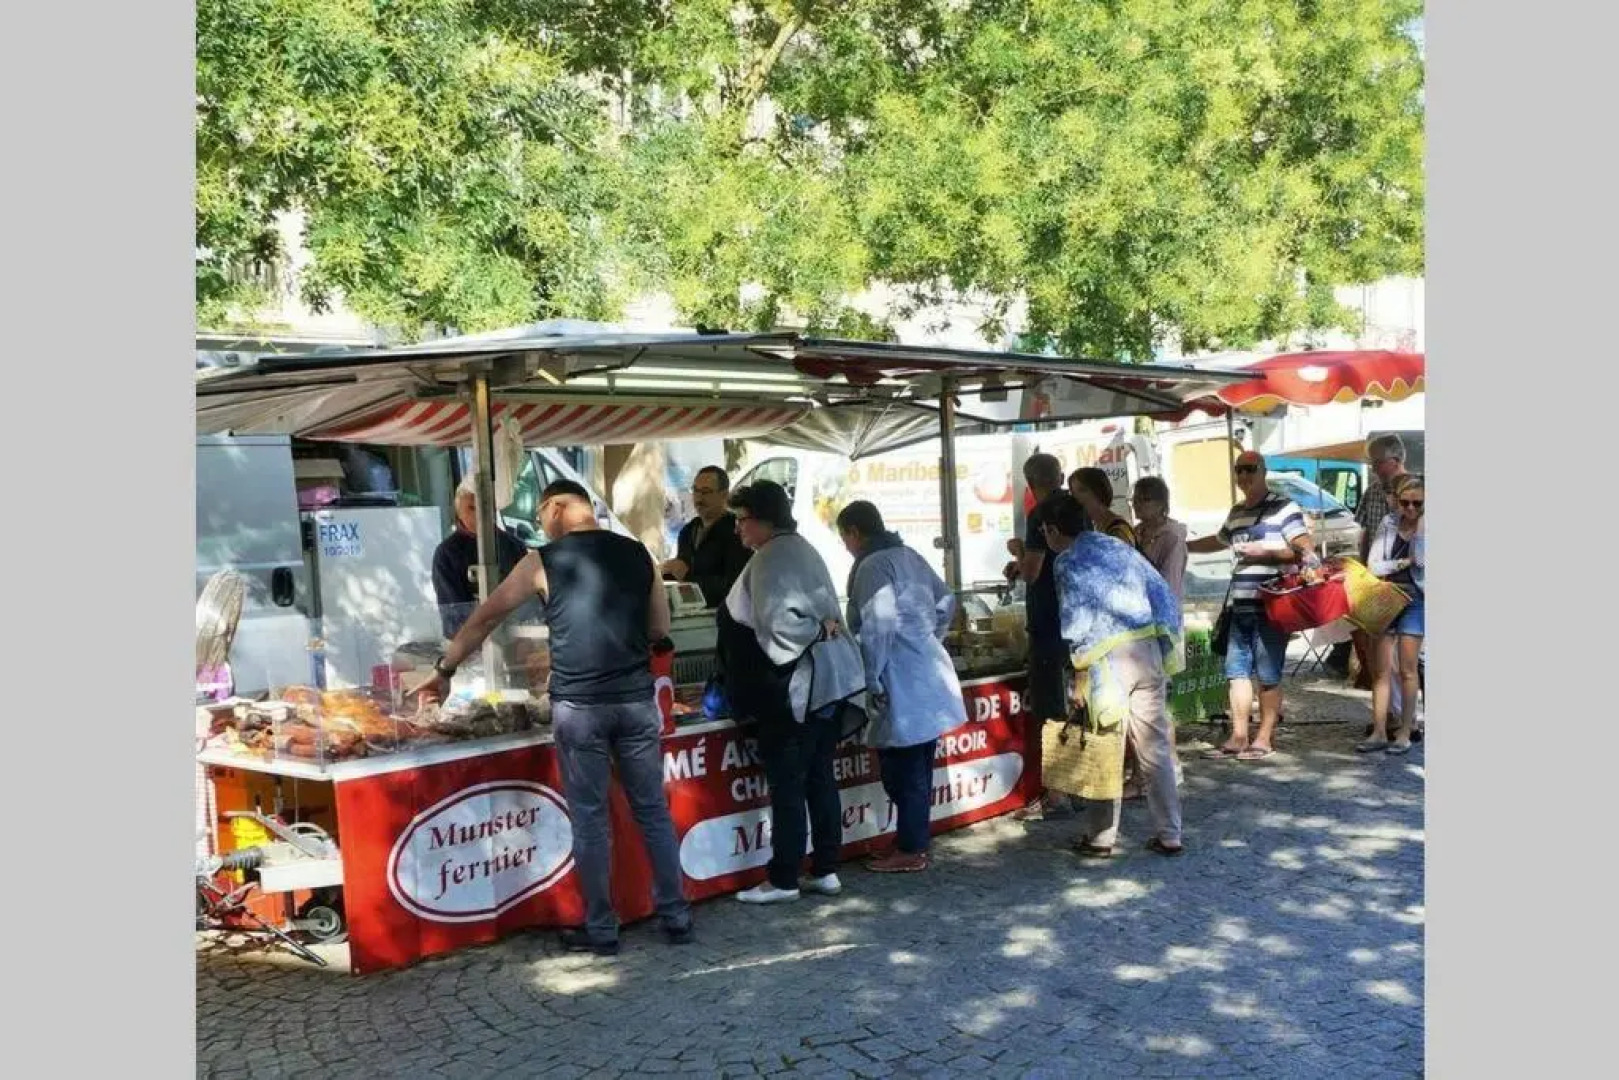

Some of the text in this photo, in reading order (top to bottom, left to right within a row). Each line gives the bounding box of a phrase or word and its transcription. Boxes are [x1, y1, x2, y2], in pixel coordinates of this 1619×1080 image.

[663, 736, 707, 783] MÉ
[720, 738, 762, 771] AR
[975, 693, 1001, 721] DE
[832, 752, 871, 781] ERIE
[934, 729, 987, 760] RROIR
[928, 772, 993, 807] mier
[428, 806, 540, 851] Munster
